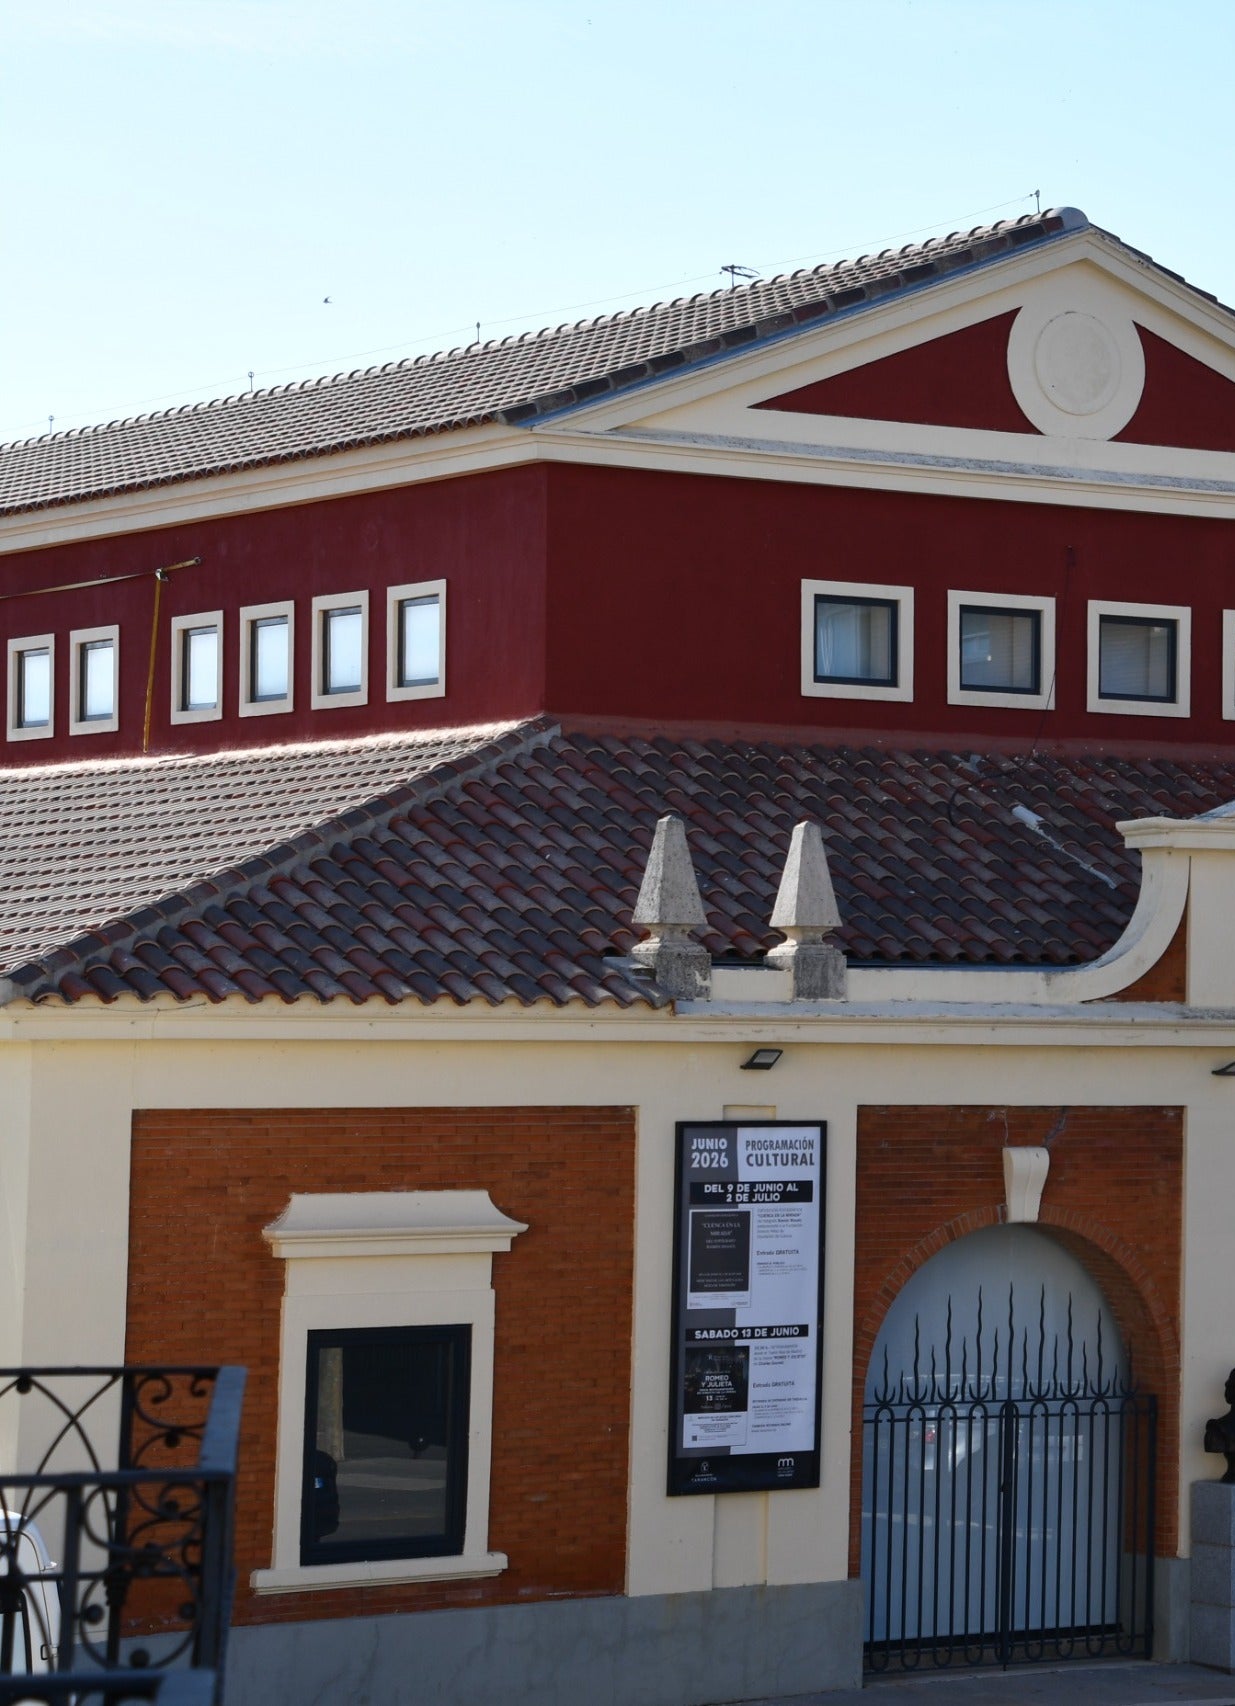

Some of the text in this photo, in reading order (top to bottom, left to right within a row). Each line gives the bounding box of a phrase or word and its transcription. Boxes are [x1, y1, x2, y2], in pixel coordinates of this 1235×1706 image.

[691, 1138, 728, 1150] JUNIO
[746, 1137, 814, 1151] PROGRAMACIÓN
[691, 1152, 728, 1168] 2026
[746, 1153, 815, 1167] CULTURAL
[704, 1182, 799, 1193] DEL 9 DE JUNIO AL
[726, 1193, 780, 1202] 2 DE JULIO
[694, 1327, 800, 1339] SABADO 13 DE JUNIO
